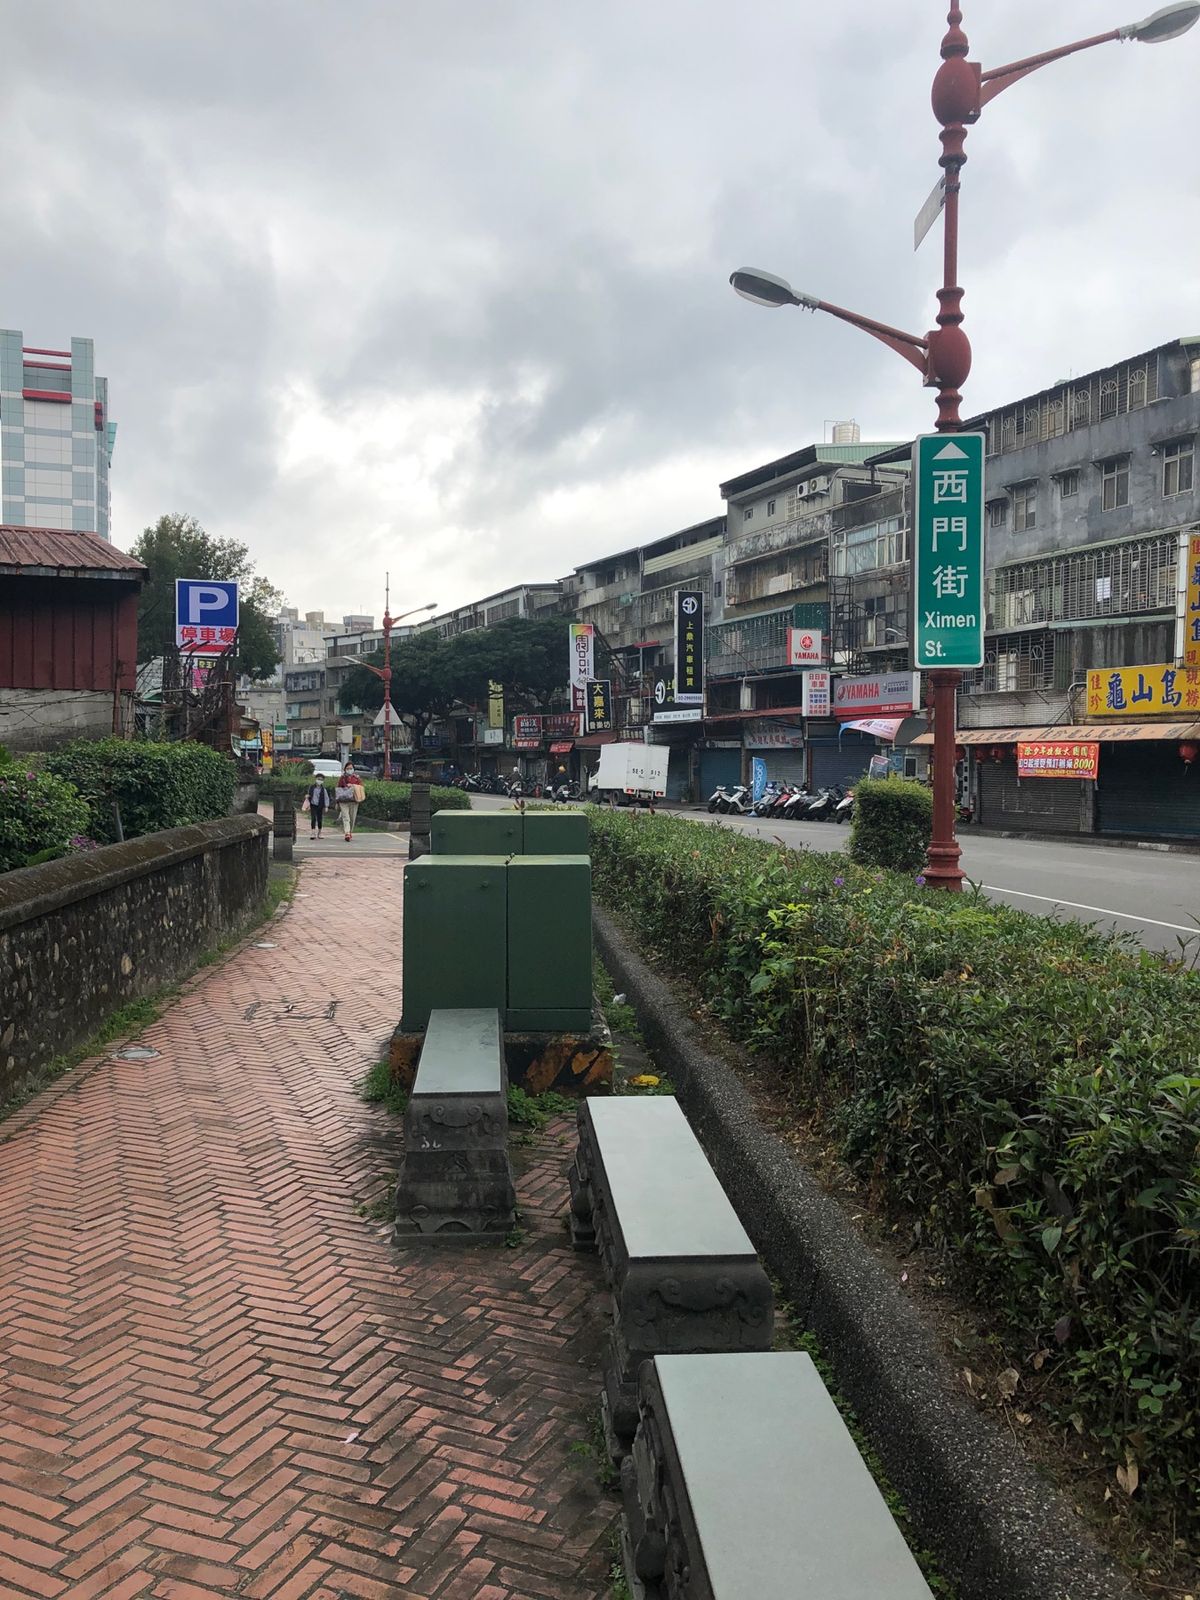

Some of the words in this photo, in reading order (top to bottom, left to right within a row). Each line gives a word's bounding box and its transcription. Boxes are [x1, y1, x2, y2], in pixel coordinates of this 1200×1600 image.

[932, 470, 968, 599] 西門街
[188, 586, 229, 623] P
[924, 611, 976, 629] Ximen
[181, 626, 236, 642] 停車場
[795, 651, 819, 660] YAMAHA
[925, 640, 946, 658] St.
[846, 683, 880, 700] YAMAHA
[1090, 674, 1102, 711] 佳珍
[1106, 669, 1182, 710] 龜山島
